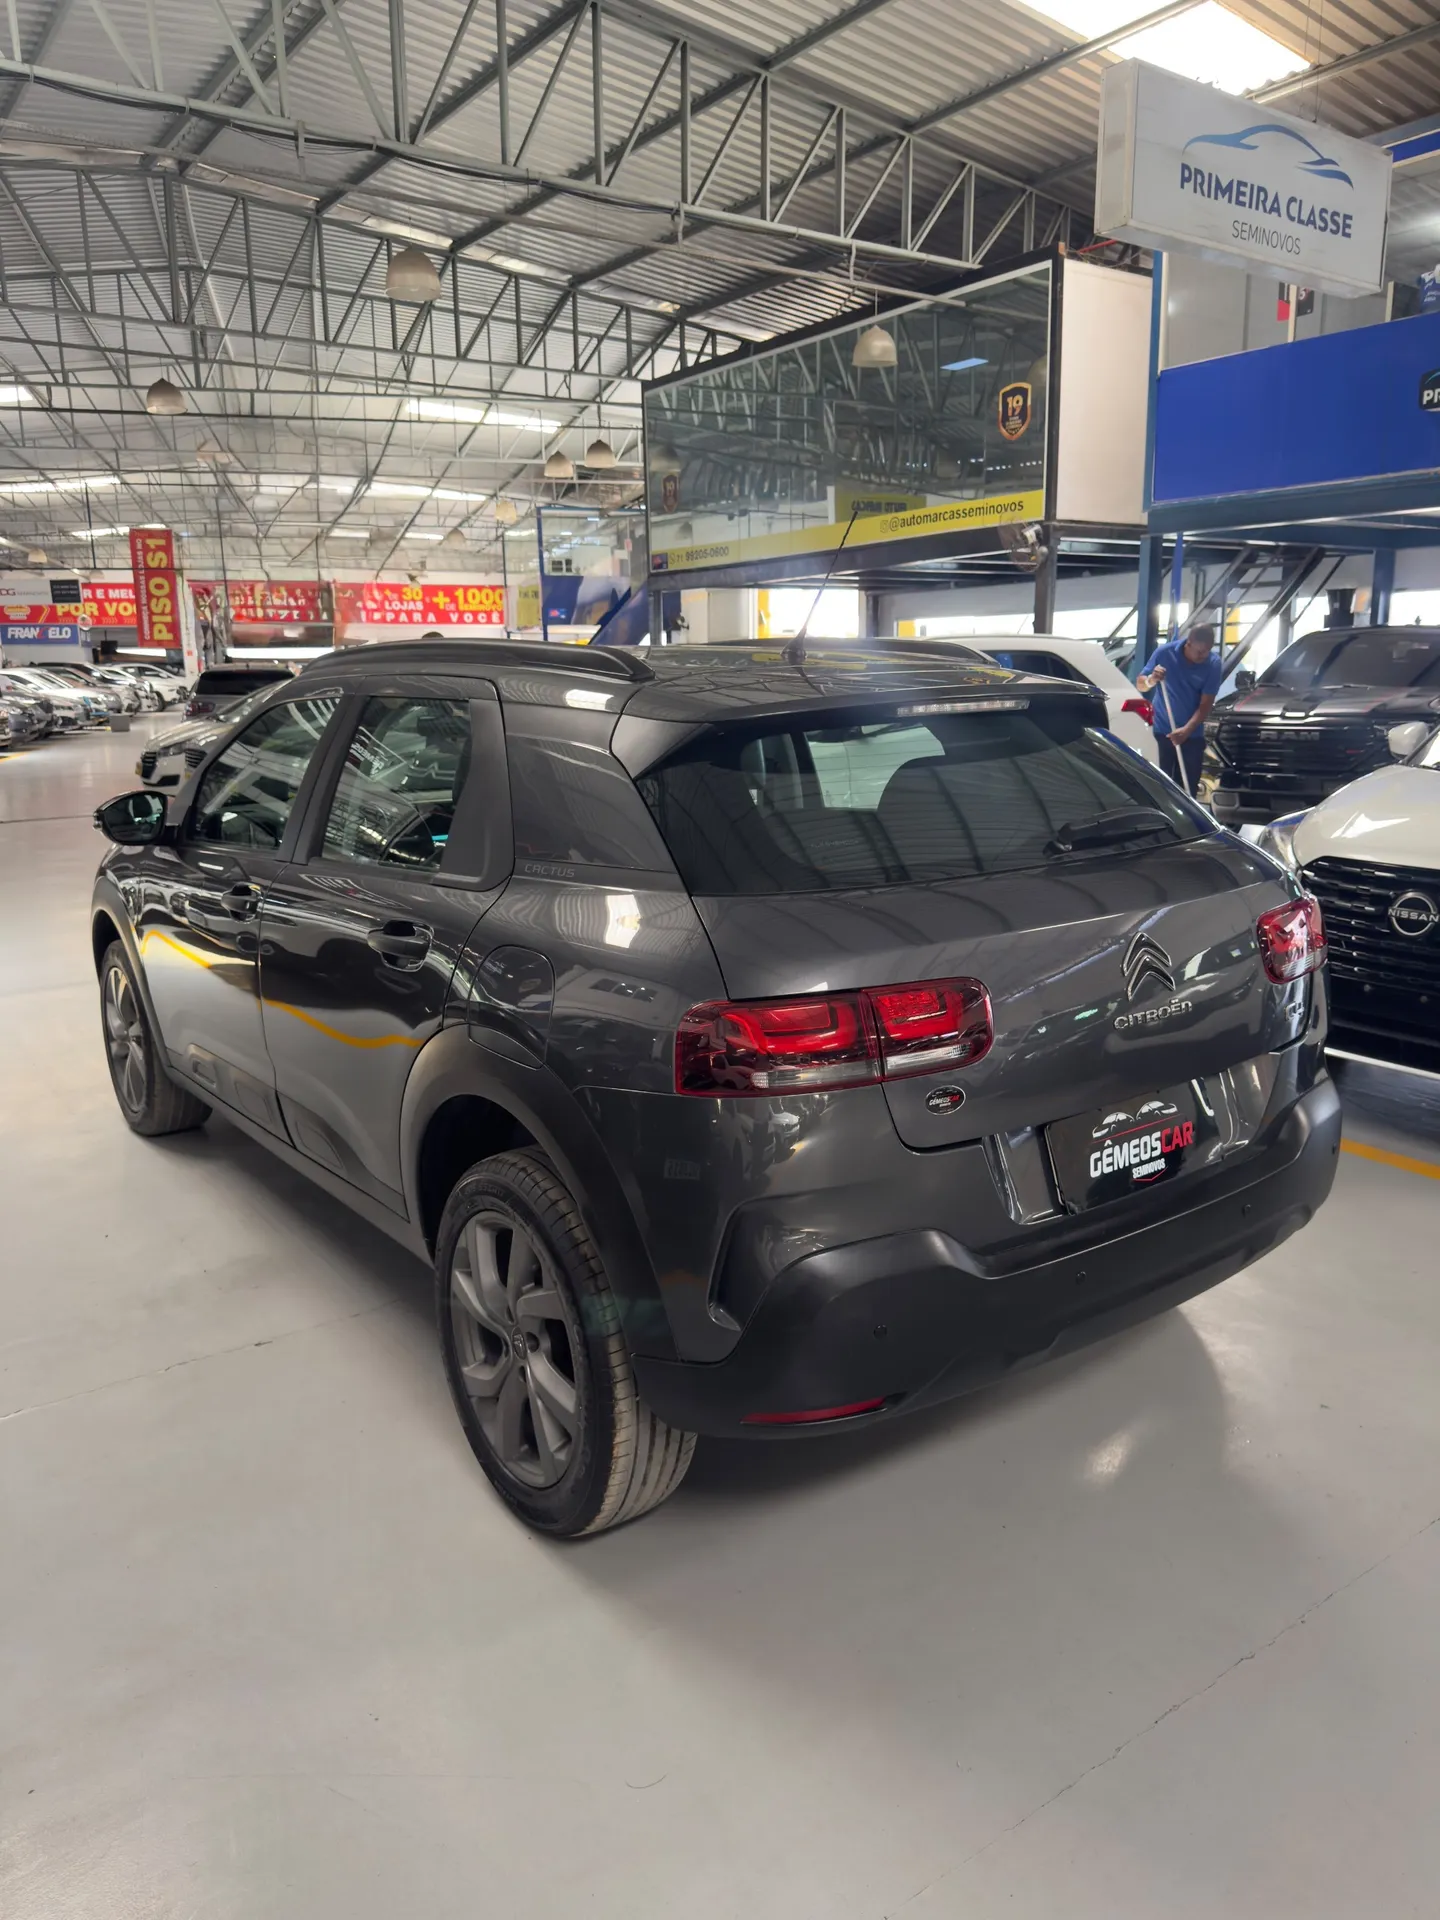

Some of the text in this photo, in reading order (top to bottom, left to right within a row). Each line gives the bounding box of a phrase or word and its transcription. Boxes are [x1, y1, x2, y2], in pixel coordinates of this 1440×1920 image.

[1180, 162, 1353, 239] PRIMEIRA CLASSE
[1232, 219, 1301, 255] SEMINOVOS
[889, 500, 1024, 532] @automarcasseminovos
[108, 589, 136, 599] MEL
[145, 538, 174, 641] PISO S1
[402, 587, 423, 600] 30
[56, 602, 137, 616] POR VO
[384, 601, 424, 611] LOJAS
[386, 610, 500, 623] PARA VOCÊ
[1260, 730, 1320, 740] RAM
[524, 862, 575, 878] CACTUS
[1388, 907, 1439, 923] NISSAN
[1113, 999, 1193, 1030] CITROËN
[1089, 1121, 1193, 1178] GÊMEOSCAR
[1132, 1158, 1166, 1179] SEMINOVOS
